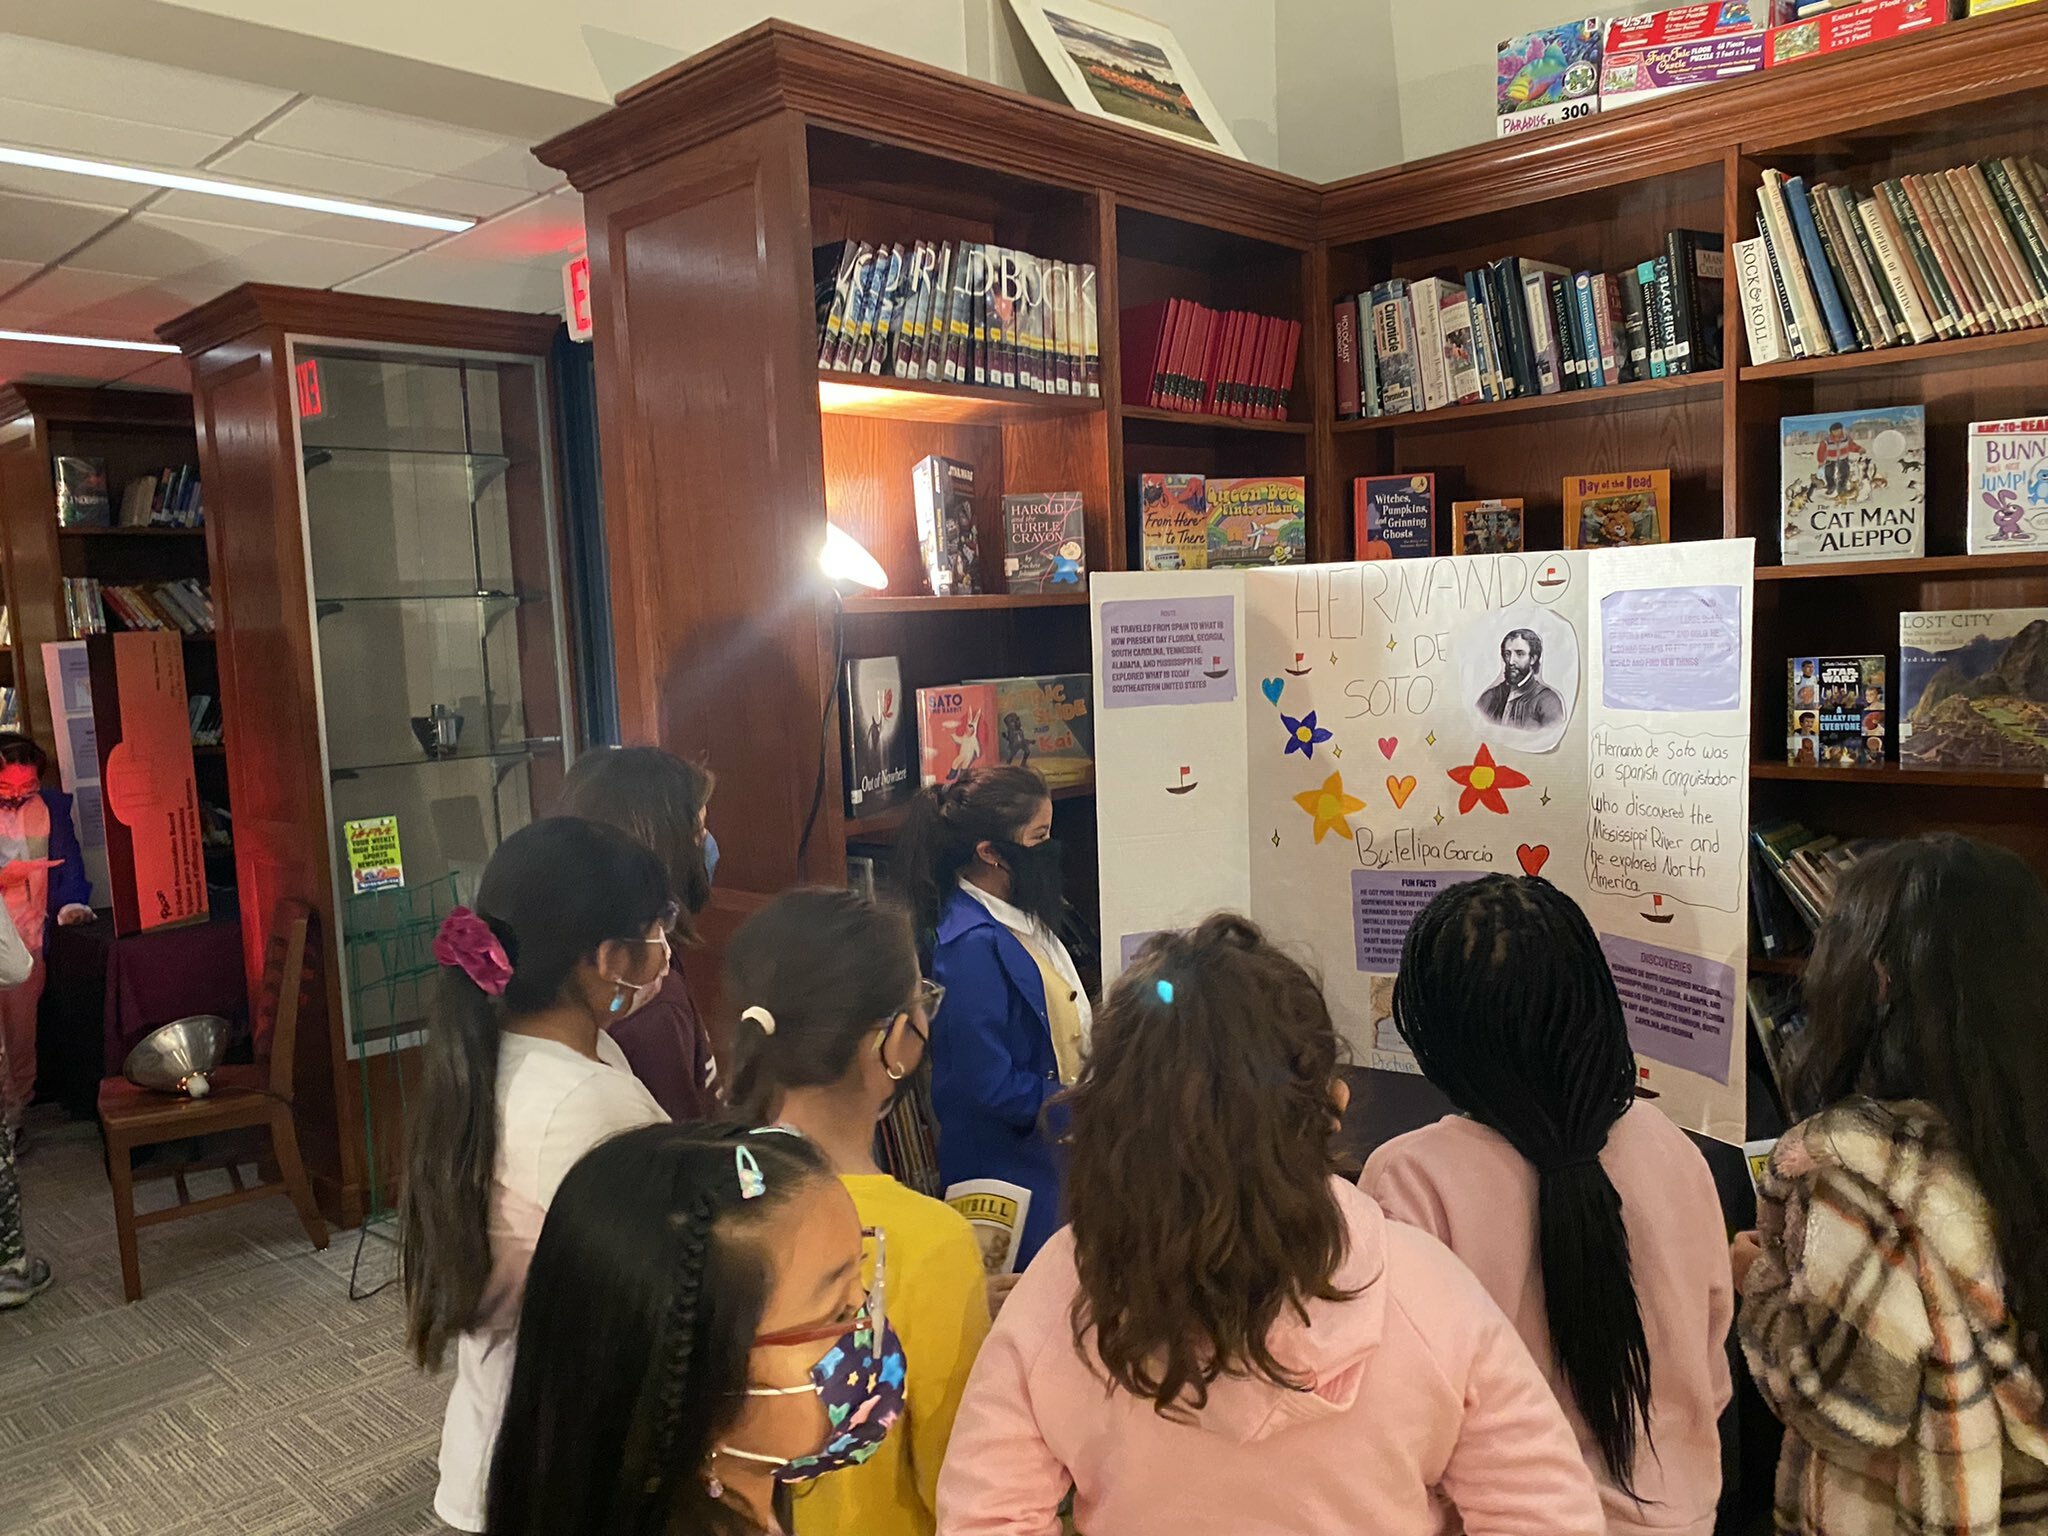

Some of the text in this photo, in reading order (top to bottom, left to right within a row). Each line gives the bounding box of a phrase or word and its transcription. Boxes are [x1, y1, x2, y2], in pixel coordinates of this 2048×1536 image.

[1690, 54, 1713, 62] PUZZLE
[1691, 46, 1712, 54] FLOOR
[1562, 103, 1589, 120] 300
[1504, 114, 1547, 133] PARADISE
[1998, 172, 2007, 186] The
[2003, 184, 2017, 203] World
[2018, 212, 2034, 239] Winslow
[2029, 237, 2043, 258] Homer
[1865, 204, 1911, 313] ENCYCLOPEDIA OF PAINTING
[1659, 275, 1671, 314] BLACK
[1742, 242, 1768, 344] ROCK & ROLL
[1580, 290, 1592, 342] Intermediate
[1647, 305, 1655, 337] AMERICAN
[1385, 303, 1399, 353] Chronicle
[1342, 315, 1350, 363] HOLOCAUST
[1384, 390, 1409, 403] Chronicle
[1986, 438, 2046, 463] BUNN
[1579, 479, 1599, 496] Day
[1602, 480, 1610, 489] of
[1627, 475, 1652, 489] Dead
[1979, 471, 2026, 492] JUMP!
[1206, 483, 1297, 506] Queen Bee
[1375, 494, 1411, 504] Witches,
[1011, 504, 1063, 515] HAROLD
[1221, 502, 1299, 516] Finds a Home
[1382, 504, 1428, 517] Pumpkins,
[1012, 521, 1060, 533] PURPLE
[1145, 512, 1207, 528] From Here
[1375, 517, 1426, 528] and Grinning
[1810, 507, 1915, 530] CAT MAN
[1012, 532, 1062, 543] CRAYON
[1166, 529, 1206, 544] to There
[1383, 529, 1413, 539] Ghosts
[1820, 528, 1912, 552] ALEPPO
[1294, 552, 1572, 640] HERNANDO
[1110, 625, 1119, 634] HE
[1120, 624, 1152, 633] TRAVELED
[1152, 624, 1170, 632] FROM
[1171, 622, 1189, 631] SPAIN
[1190, 622, 1198, 630] TO
[1199, 621, 1216, 629] WHAT
[1903, 614, 1994, 628] LOST CITY
[1111, 638, 1125, 646] NOW
[1126, 636, 1155, 645] PRESENT
[1156, 635, 1167, 643] DAY
[1111, 649, 1132, 658] SOUTH
[1413, 631, 1450, 668] DE
[1143, 660, 1156, 668] AND
[1112, 672, 1144, 681] EXPLORED
[1145, 671, 1162, 679] WHAT
[1171, 670, 1190, 678] TODAY
[1822, 672, 1858, 683] WARS
[1112, 680, 1206, 693] SOUTHEASTERN UNITED STATES
[929, 694, 962, 708] SATO
[1343, 676, 1433, 719] SOTO
[1821, 723, 1860, 731] EVERYONE
[1038, 730, 1073, 752] Kai
[1598, 731, 1728, 760] Hernando de Soto was
[862, 775, 874, 792] Out
[881, 767, 907, 785] Nowhere
[1594, 763, 1604, 779] a
[1591, 791, 1714, 825] who discovered the
[1592, 816, 1720, 853] Mississippi River and
[363, 851, 388, 860] SPORTS
[1355, 827, 1493, 869] By: Felipa Garcia
[358, 858, 395, 868] NEWSPAPER
[1590, 842, 1705, 878] he explored North
[1402, 879, 1415, 887] FUN
[1591, 864, 1640, 891] America
[1640, 952, 1693, 974] DISCOVERIES
